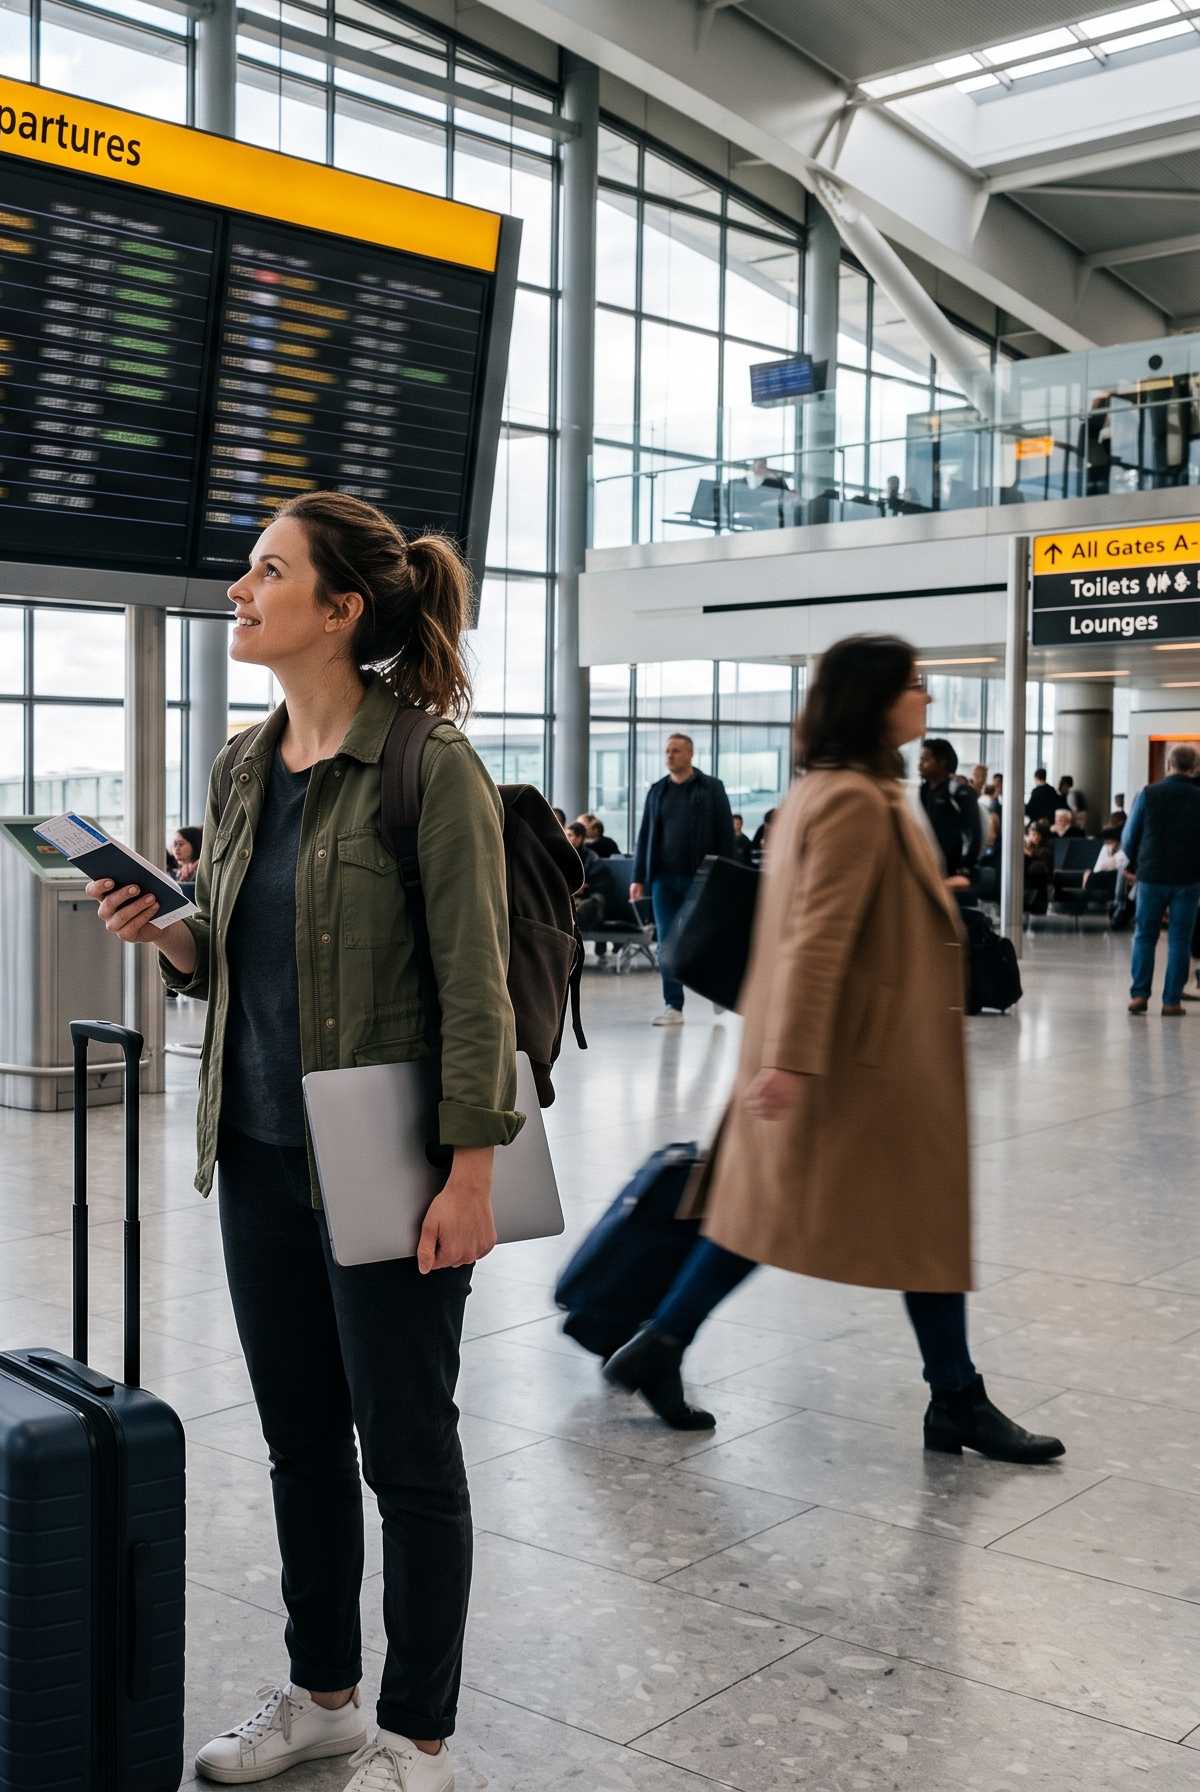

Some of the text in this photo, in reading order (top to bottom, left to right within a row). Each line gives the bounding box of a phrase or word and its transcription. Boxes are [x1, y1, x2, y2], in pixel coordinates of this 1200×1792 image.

[1071, 541, 1098, 559] All
[1106, 540, 1166, 557] Gates
[1070, 576, 1140, 598] Toilets
[1070, 615, 1159, 637] Lounges
